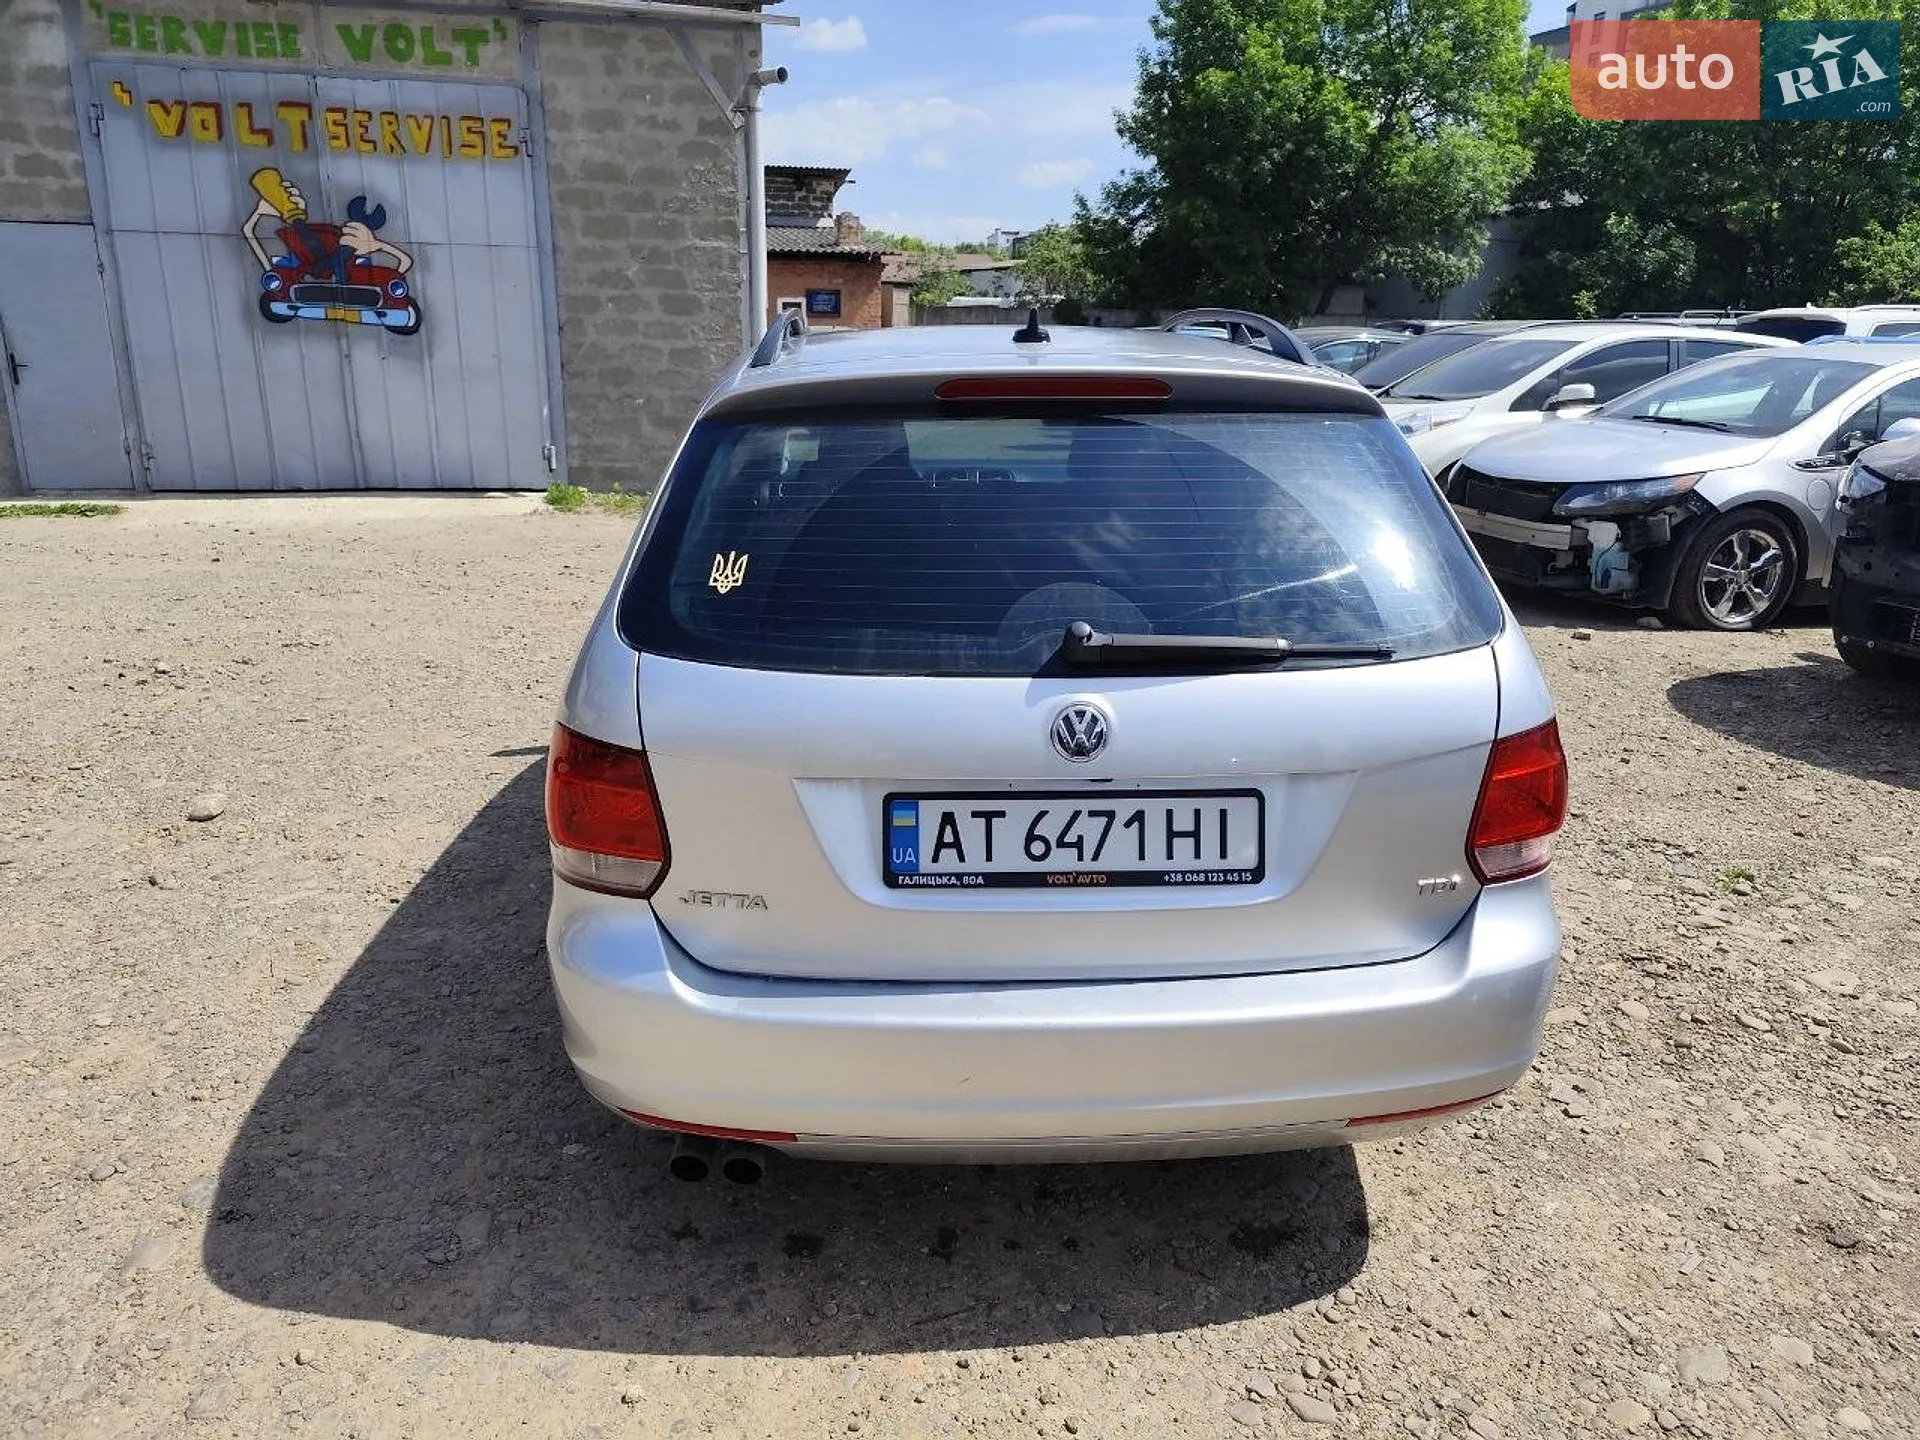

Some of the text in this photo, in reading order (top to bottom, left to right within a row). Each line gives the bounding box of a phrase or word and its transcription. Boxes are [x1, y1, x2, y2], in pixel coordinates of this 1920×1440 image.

[147, 101, 519, 158] VOLT SERVISE
[1054, 706, 1106, 759] VW
[931, 808, 1228, 863] AT 6471 HI
[892, 847, 917, 863] UA
[898, 875, 960, 886] ГАЛИЦЬКА,
[1164, 872, 1183, 883] +38
[1185, 872, 1206, 882] 068
[1207, 872, 1224, 882] 123
[1226, 872, 1239, 882] 45
[680, 889, 768, 911] JETTA
